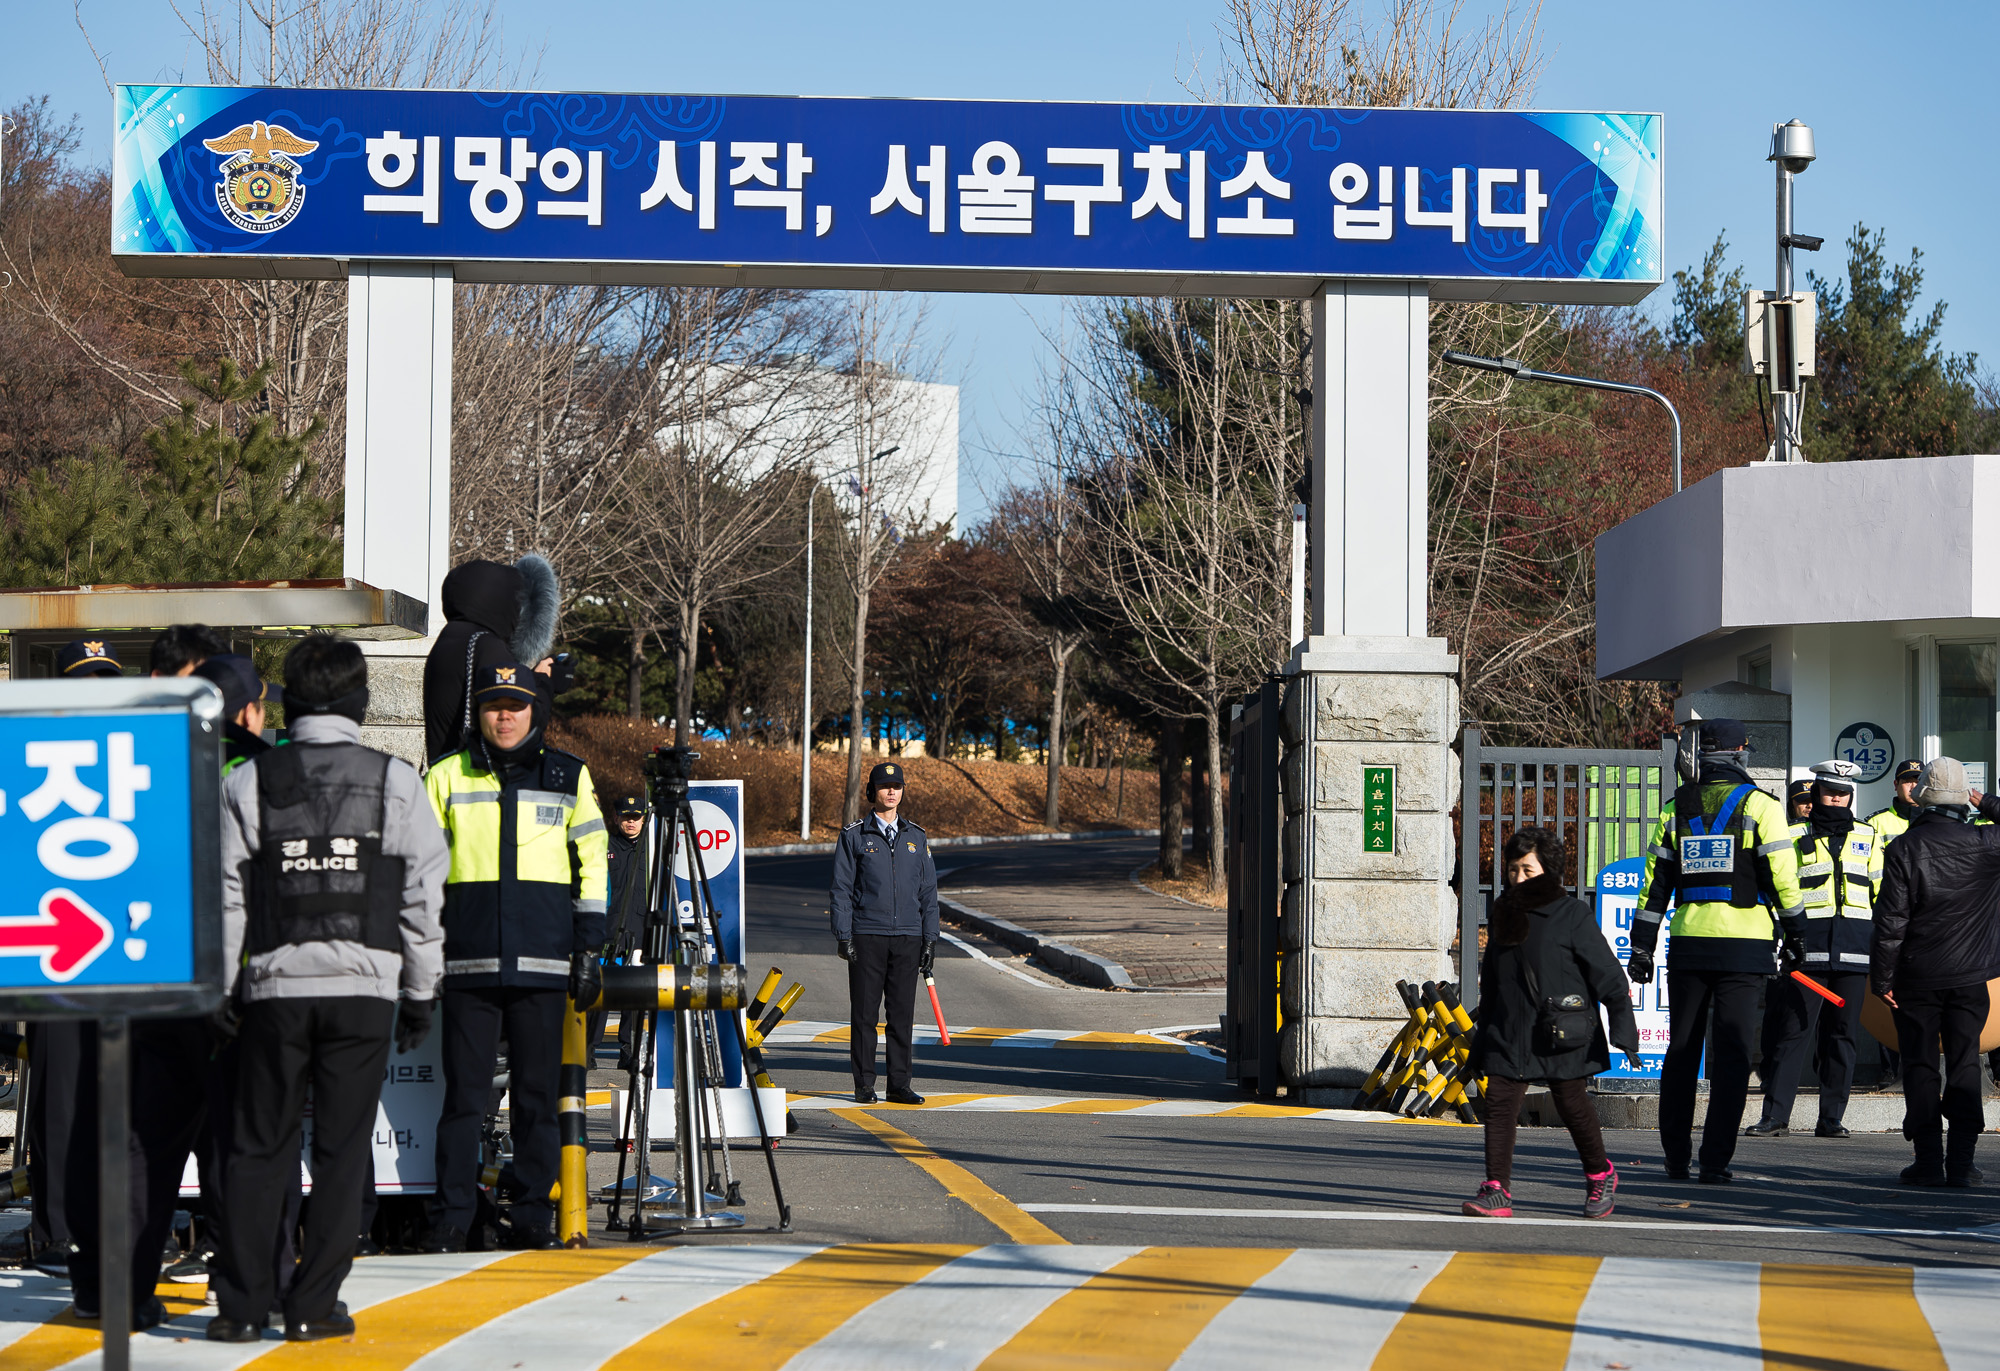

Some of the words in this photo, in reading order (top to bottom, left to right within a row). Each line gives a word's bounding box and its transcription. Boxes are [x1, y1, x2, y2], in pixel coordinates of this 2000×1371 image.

[363, 130, 603, 230] 희망의
[640, 140, 832, 238] 시작,
[870, 140, 1294, 239] 서울구치소
[1328, 161, 1548, 244] 입니다
[218, 192, 233, 216] KOREA
[231, 213, 283, 231] CORRECTIONAL
[283, 194, 303, 222] SERVICE
[1843, 748, 1887, 765] 143
[1371, 772, 1386, 848] 서울구치소
[281, 856, 359, 873] POLICE
[1686, 860, 1727, 869] POLICE
[1602, 872, 1640, 889] 승용차
